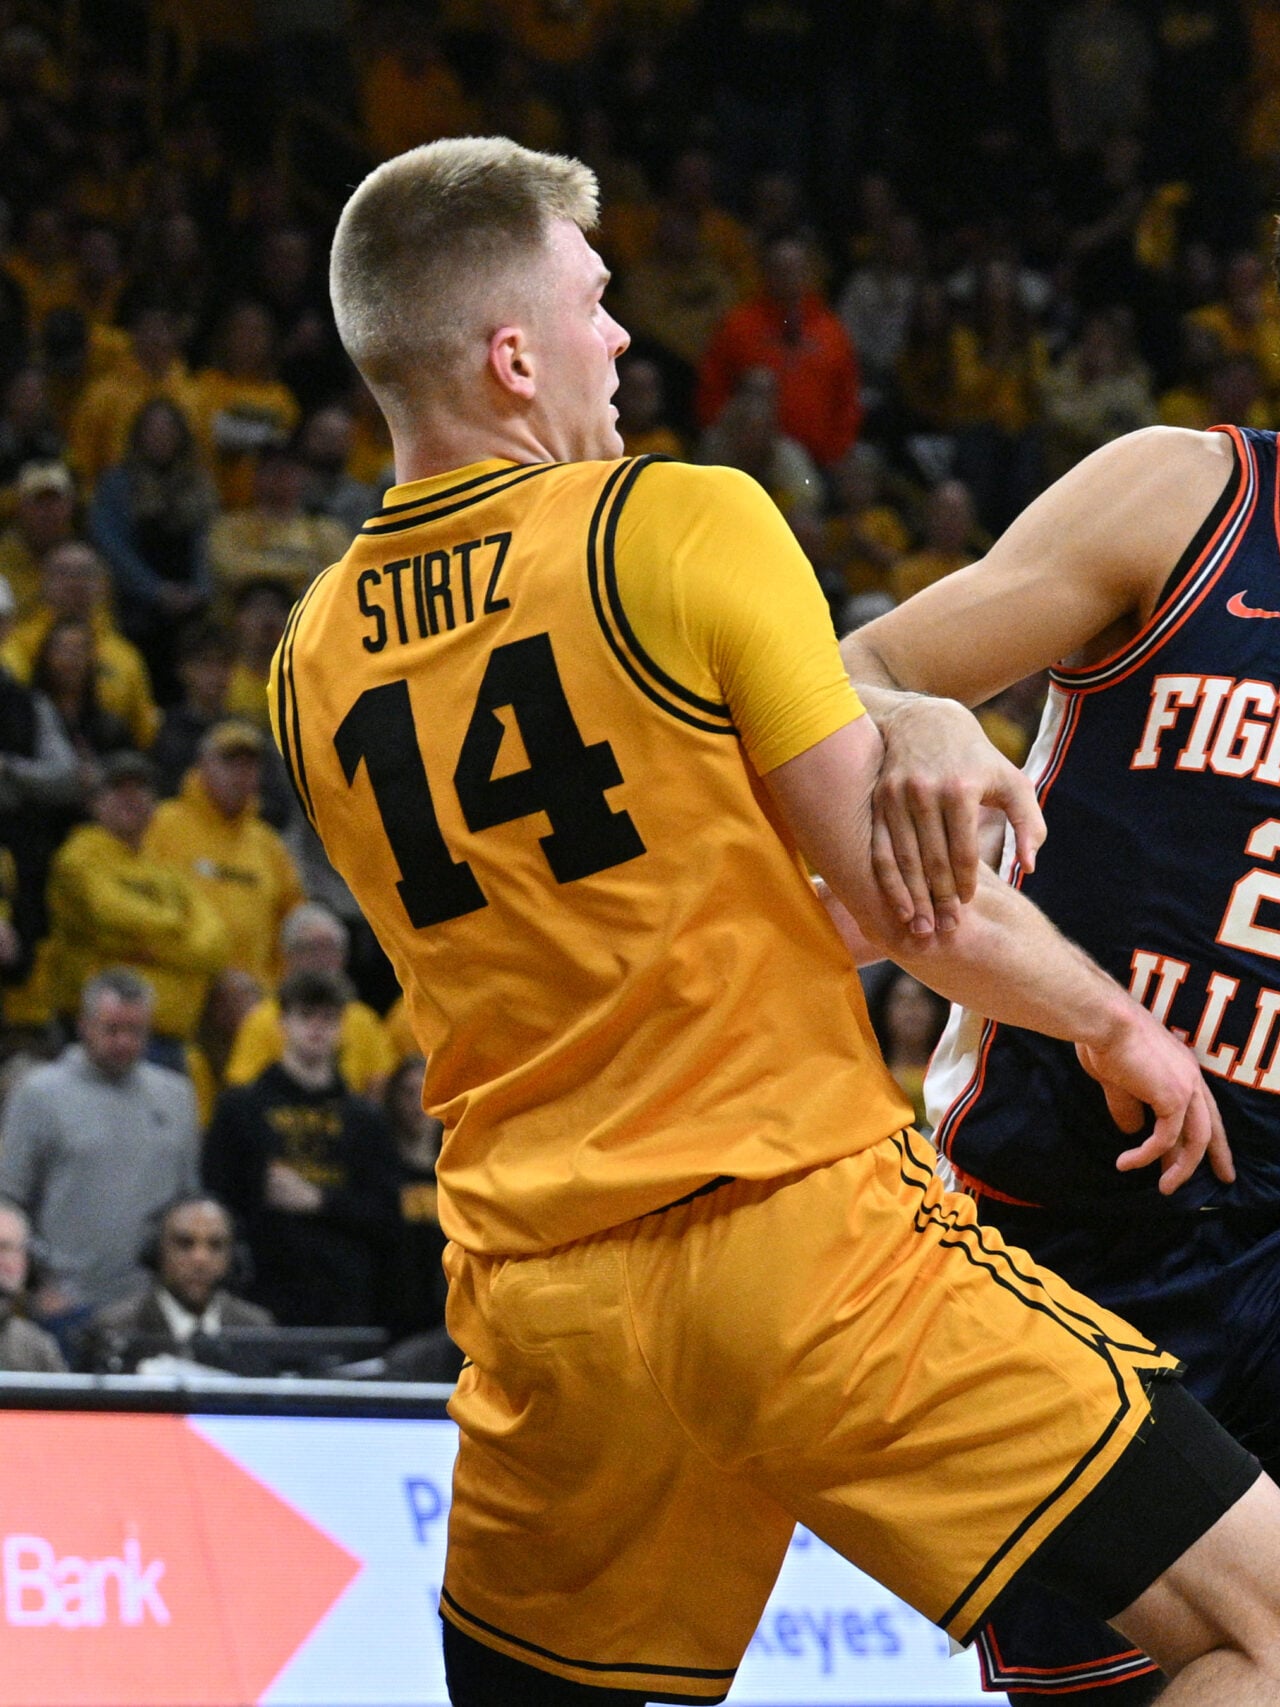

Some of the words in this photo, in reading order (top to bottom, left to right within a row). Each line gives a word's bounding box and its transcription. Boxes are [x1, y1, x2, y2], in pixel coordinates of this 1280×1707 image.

[357, 531, 512, 653] STIRTZ
[333, 632, 647, 929] 14
[4, 1530, 171, 1629] Bank
